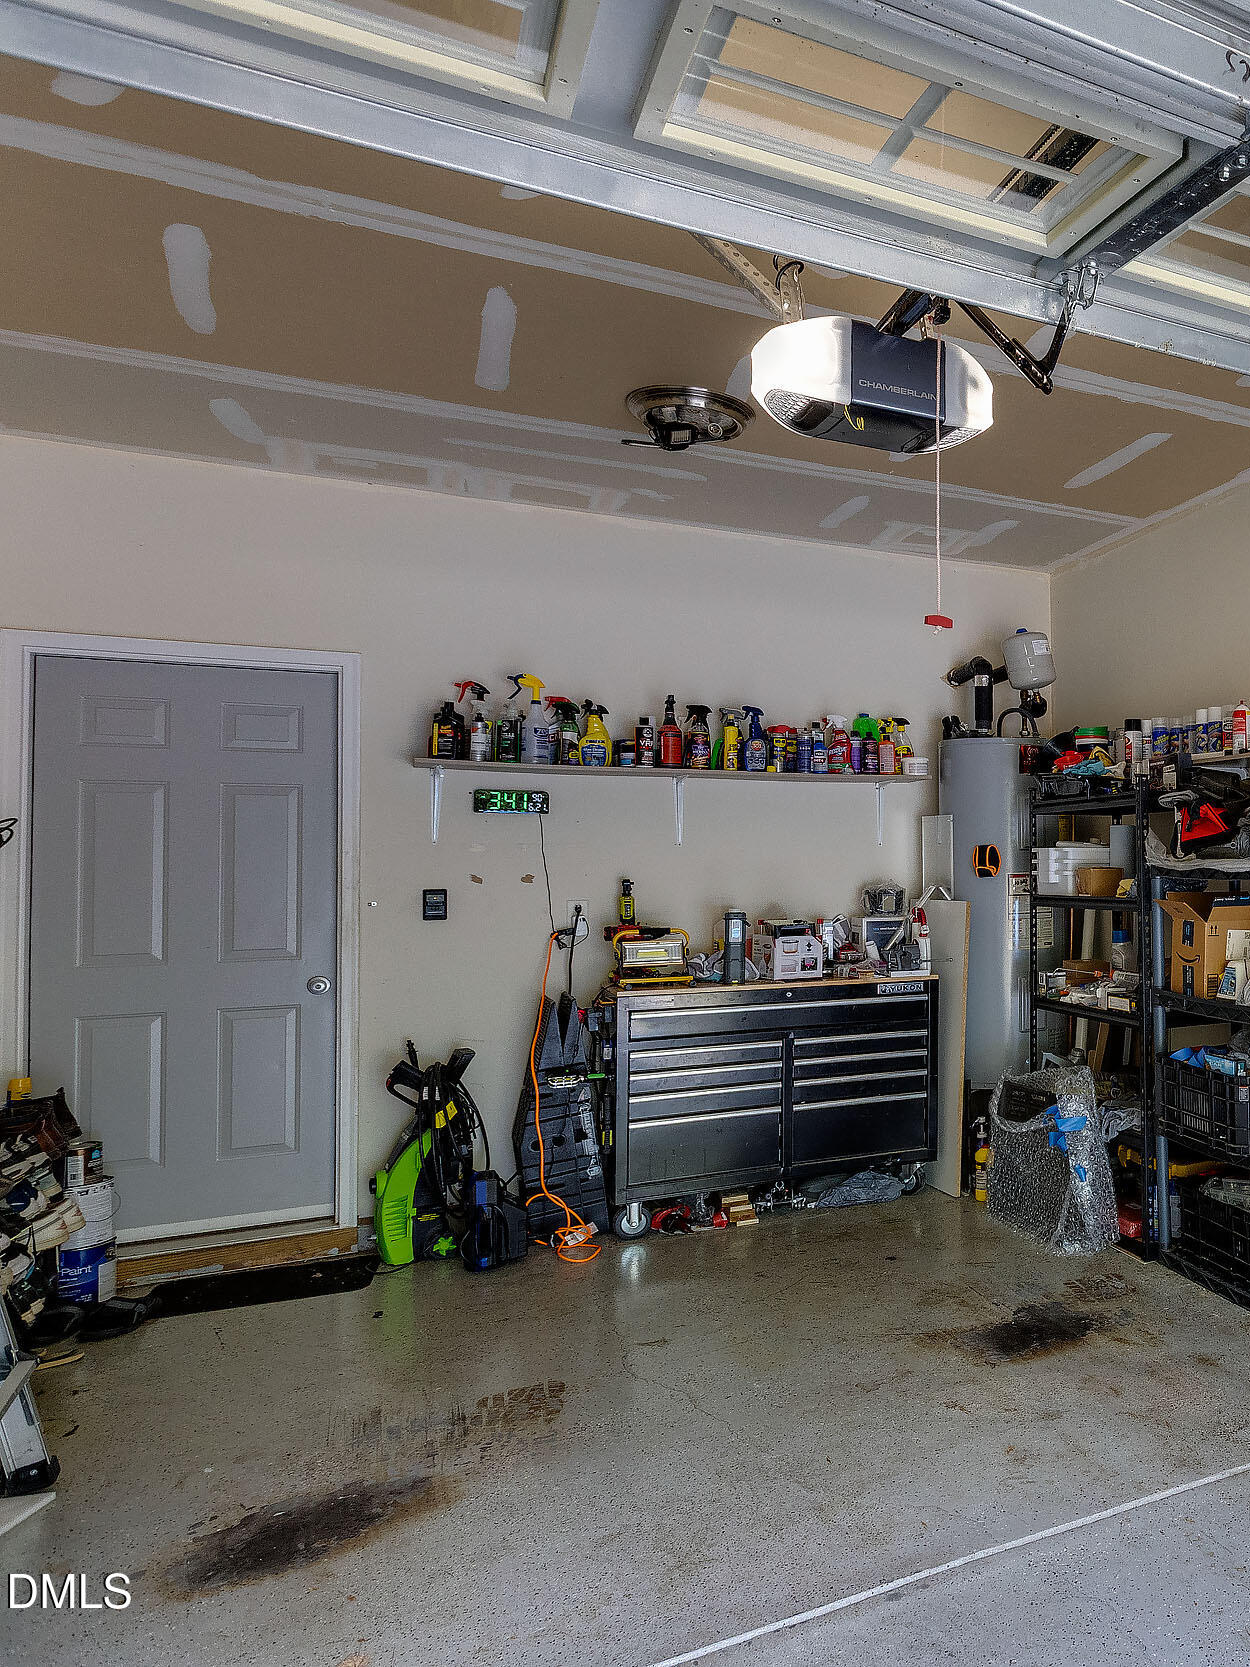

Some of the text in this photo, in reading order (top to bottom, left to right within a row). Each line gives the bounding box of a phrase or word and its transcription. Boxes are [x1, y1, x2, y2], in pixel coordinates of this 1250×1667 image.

[858, 379, 938, 401] CHAMBERLAIN
[889, 984, 923, 993] YUKON
[61, 1264, 93, 1277] Paint
